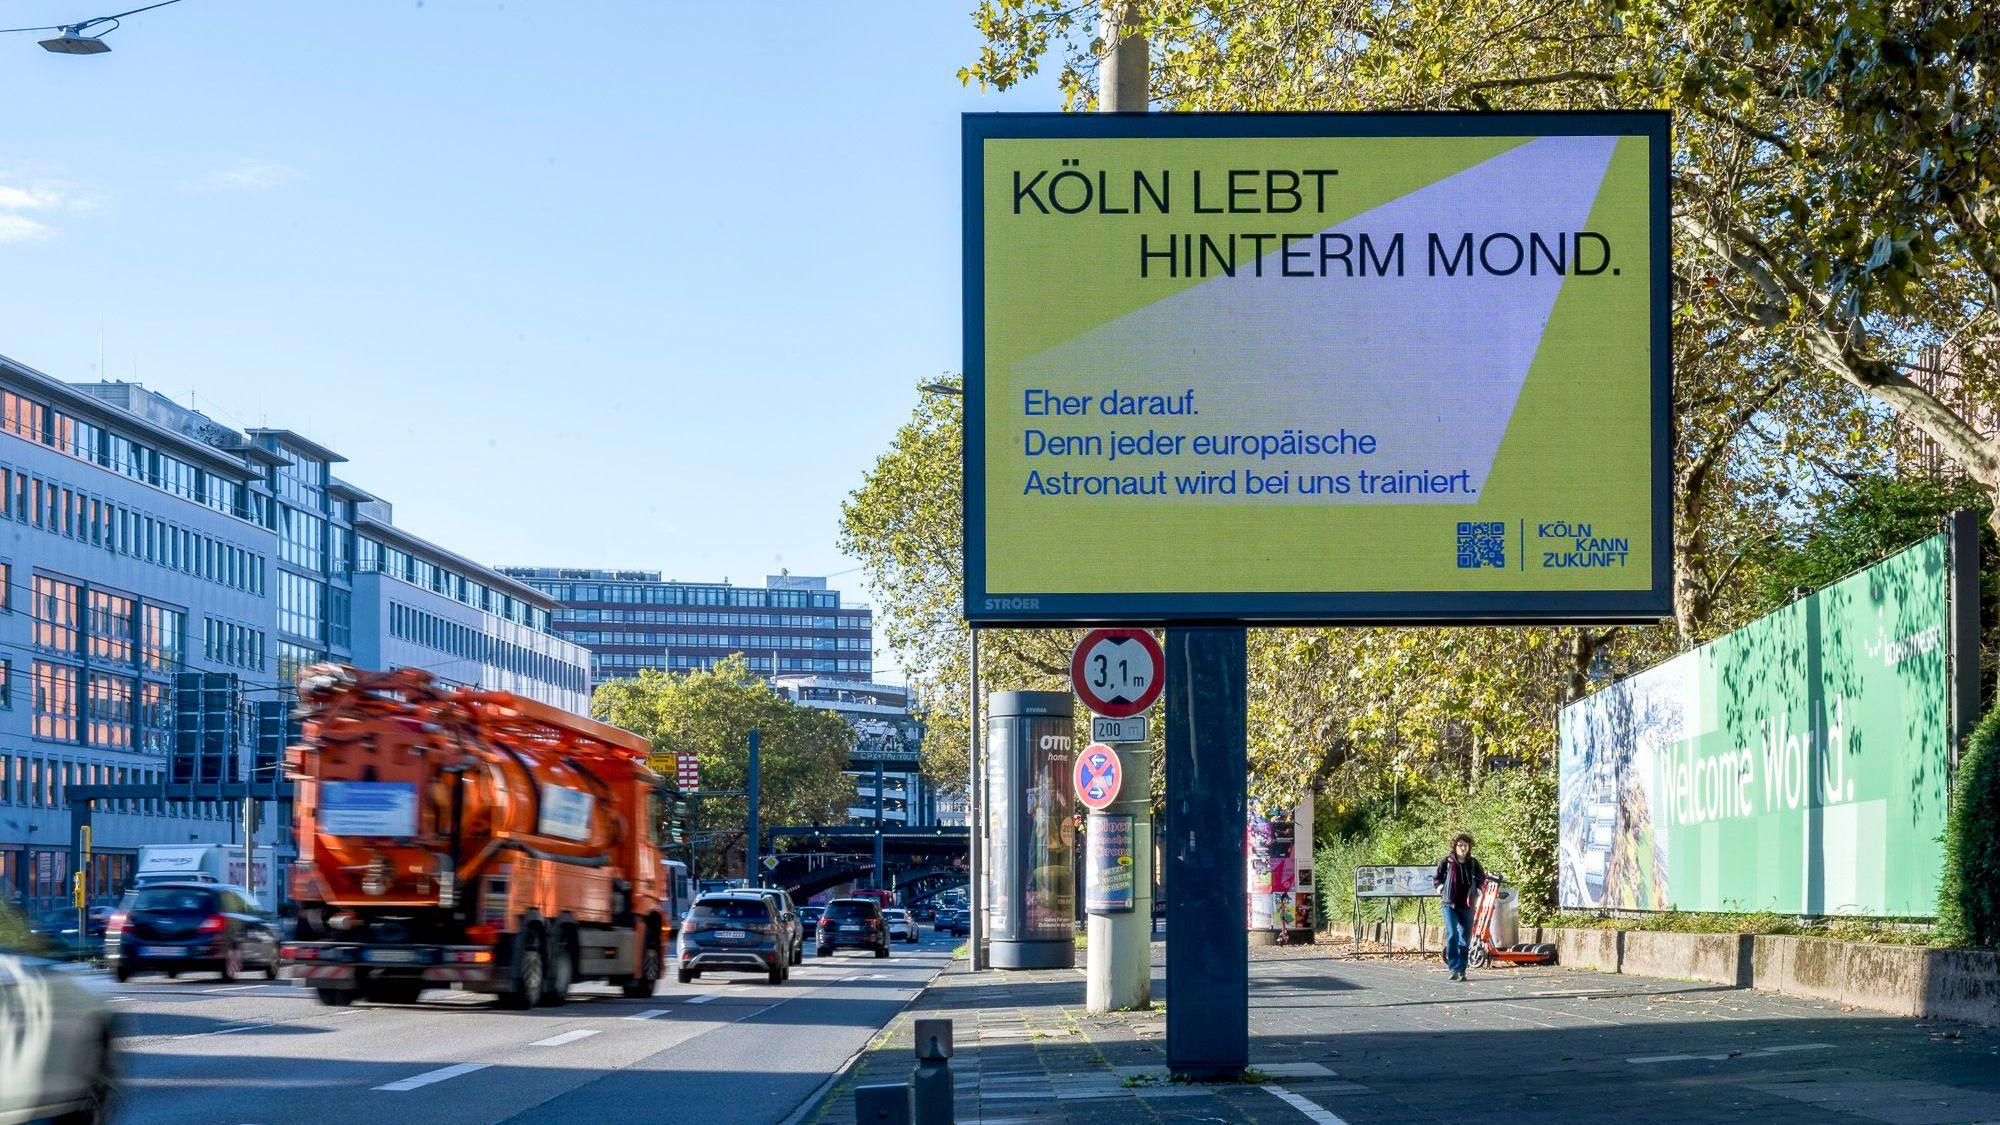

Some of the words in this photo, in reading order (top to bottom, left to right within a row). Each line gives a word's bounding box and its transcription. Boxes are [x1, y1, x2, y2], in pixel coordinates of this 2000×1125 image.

[1013, 158, 1170, 215] KÖLN
[1193, 169, 1339, 214] LEBT
[1140, 233, 1404, 278] HINTERM
[1428, 231, 1621, 277] MOND.
[1024, 390, 1093, 416] Eher
[1099, 388, 1199, 416] darauf.
[1024, 430, 1102, 456] Denn
[1108, 429, 1187, 460] jeder
[1192, 429, 1377, 457] europäische
[1023, 470, 1168, 496] Astronaut
[1174, 469, 1236, 495] wird
[1245, 469, 1290, 495] bei
[1297, 476, 1351, 495] uns
[1358, 468, 1477, 495] trainiert.
[1538, 520, 1592, 538] KÖLN
[1575, 538, 1629, 552] KANN
[1542, 552, 1629, 568] ZUKUNFT
[985, 597, 1040, 610] STRÖER
[1093, 654, 1128, 690] 3,1
[1133, 675, 1144, 687] m
[1099, 722, 1120, 737] 200
[1048, 752, 1068, 761] home
[1660, 735, 1753, 828] Welcome
[1760, 692, 1855, 813] World.
